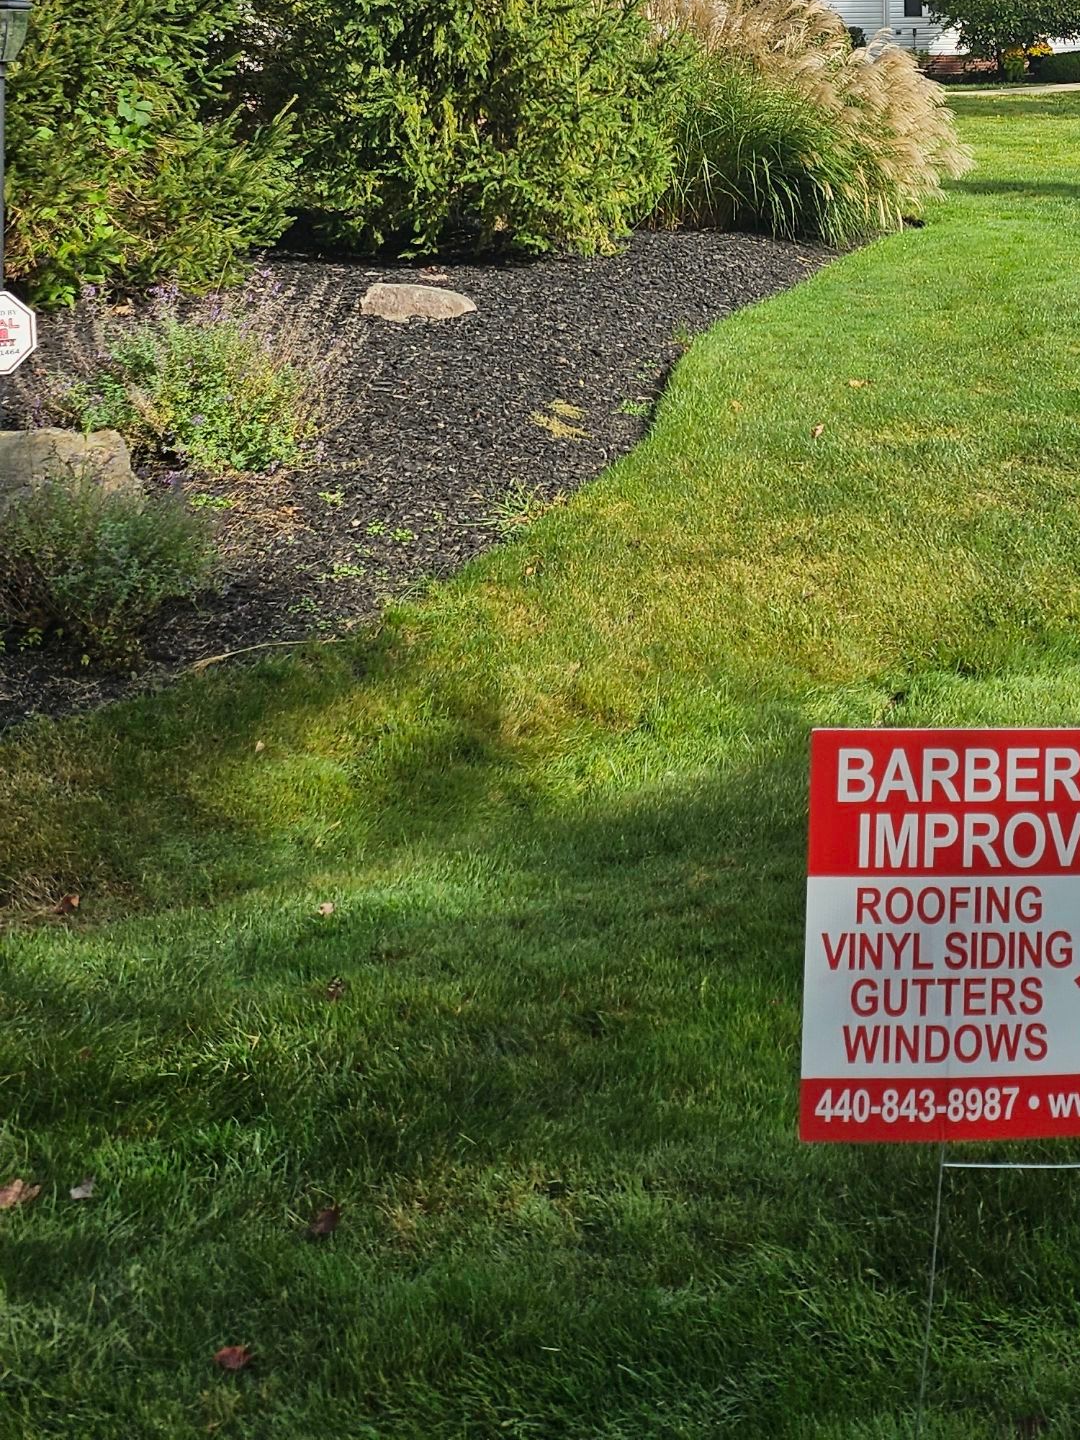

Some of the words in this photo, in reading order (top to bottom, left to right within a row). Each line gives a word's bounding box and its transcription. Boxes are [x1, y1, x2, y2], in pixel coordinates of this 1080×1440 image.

[856, 886, 1043, 924] ROOFING
[822, 932, 933, 970] VINYL
[944, 931, 1073, 969] SIDING
[851, 977, 1043, 1016] GUTTERS
[843, 1023, 1048, 1064] WINDOWS
[814, 1087, 1019, 1122] 440-843-8987
